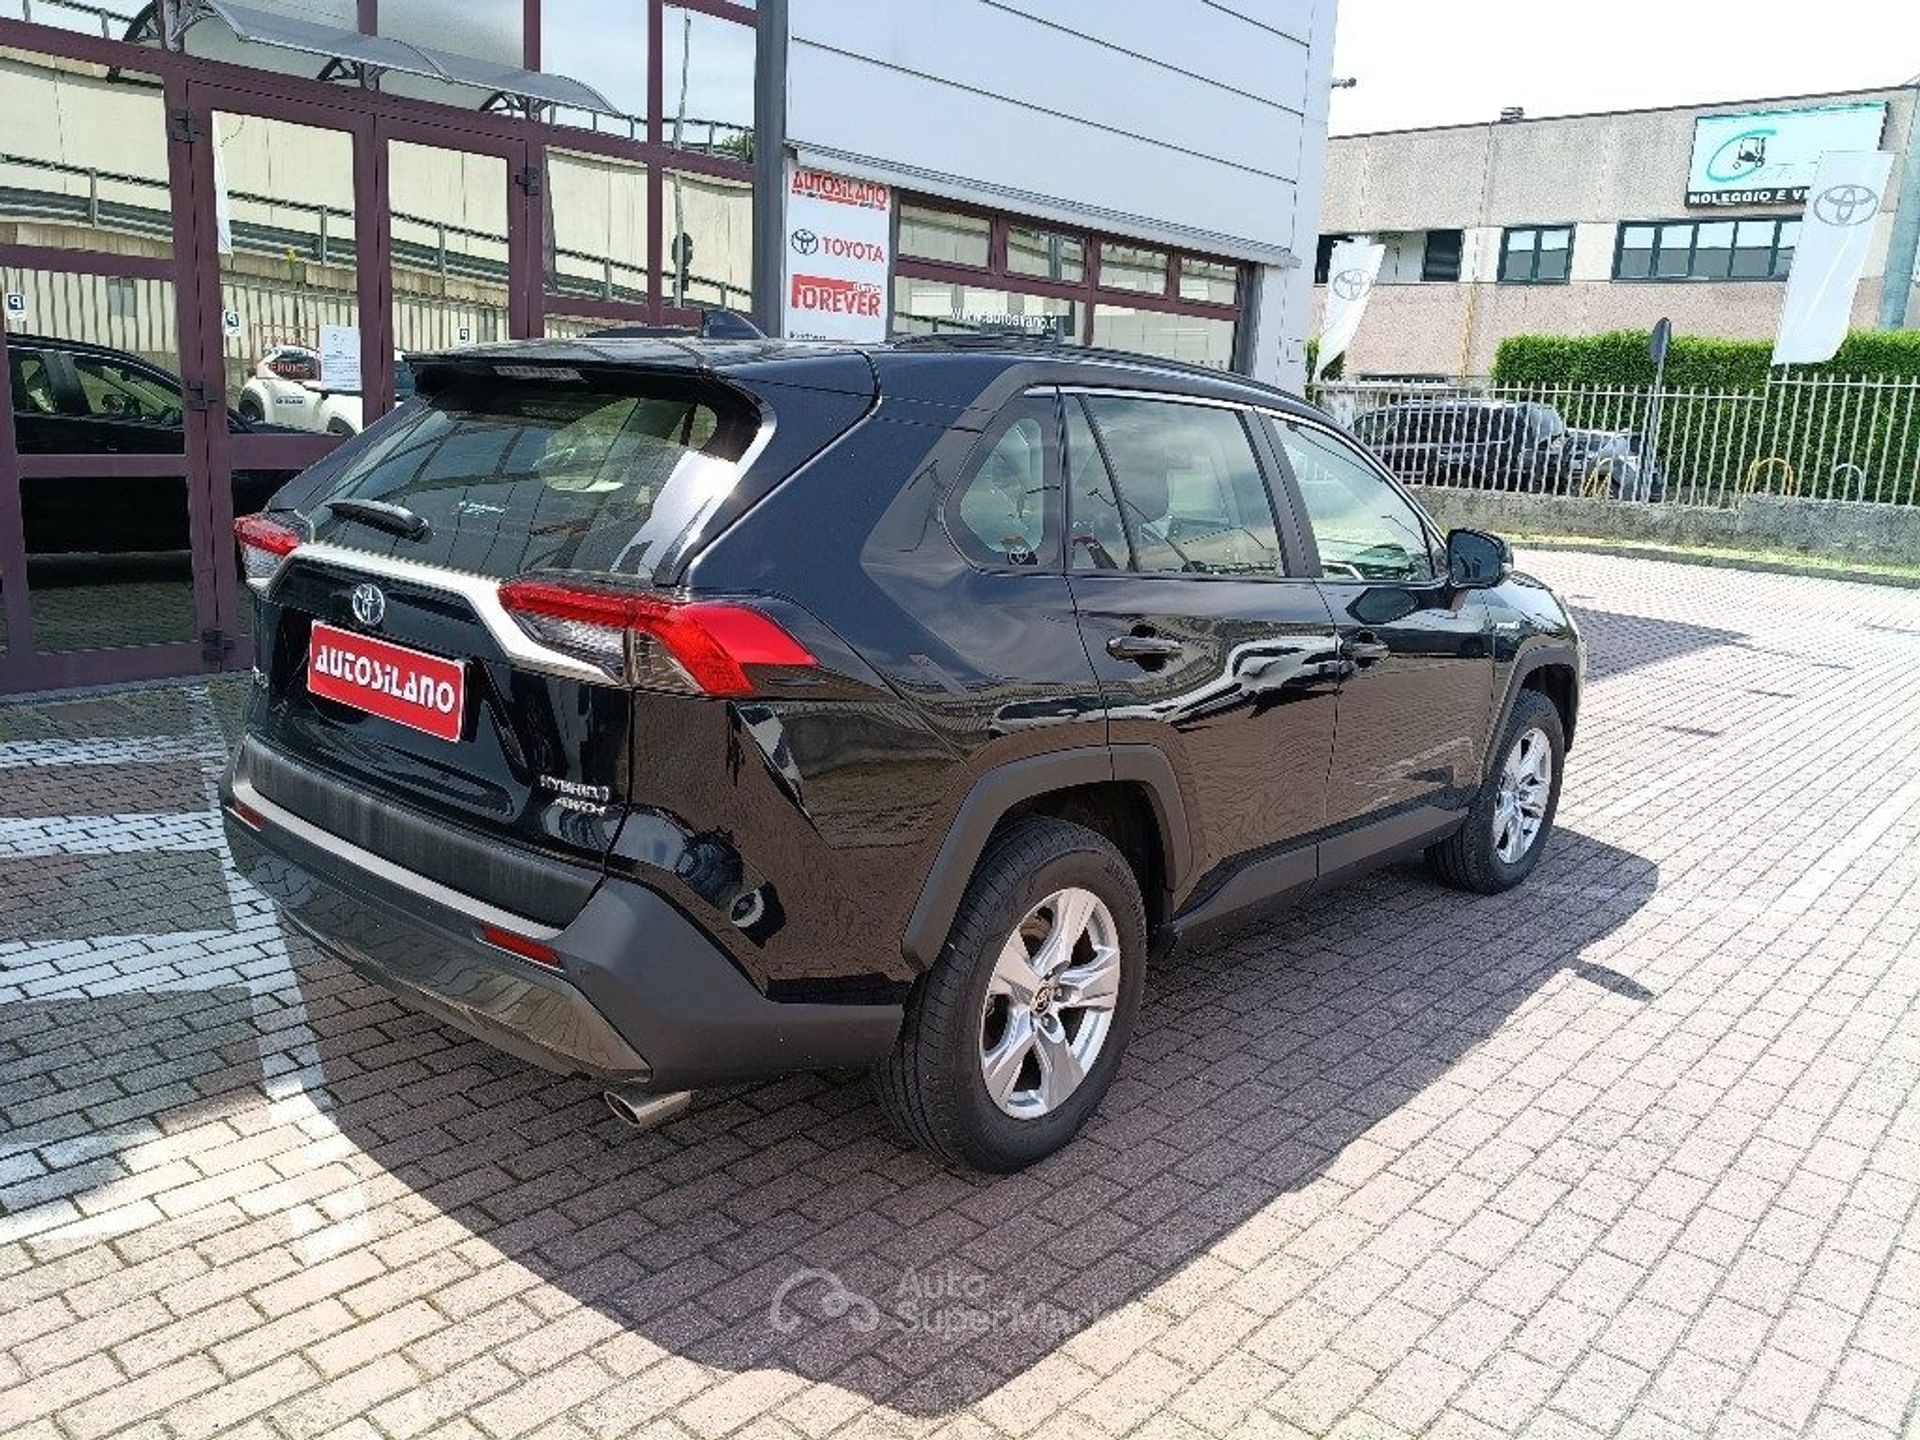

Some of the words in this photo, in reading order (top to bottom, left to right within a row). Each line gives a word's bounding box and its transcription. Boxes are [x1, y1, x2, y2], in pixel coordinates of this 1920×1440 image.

[1689, 190, 1771, 204] NOLEGGIO
[1775, 189, 1786, 200] E
[822, 236, 884, 262] TOYOTA
[791, 274, 882, 317] FOREVER
[315, 645, 456, 714] AUTOSILANO
